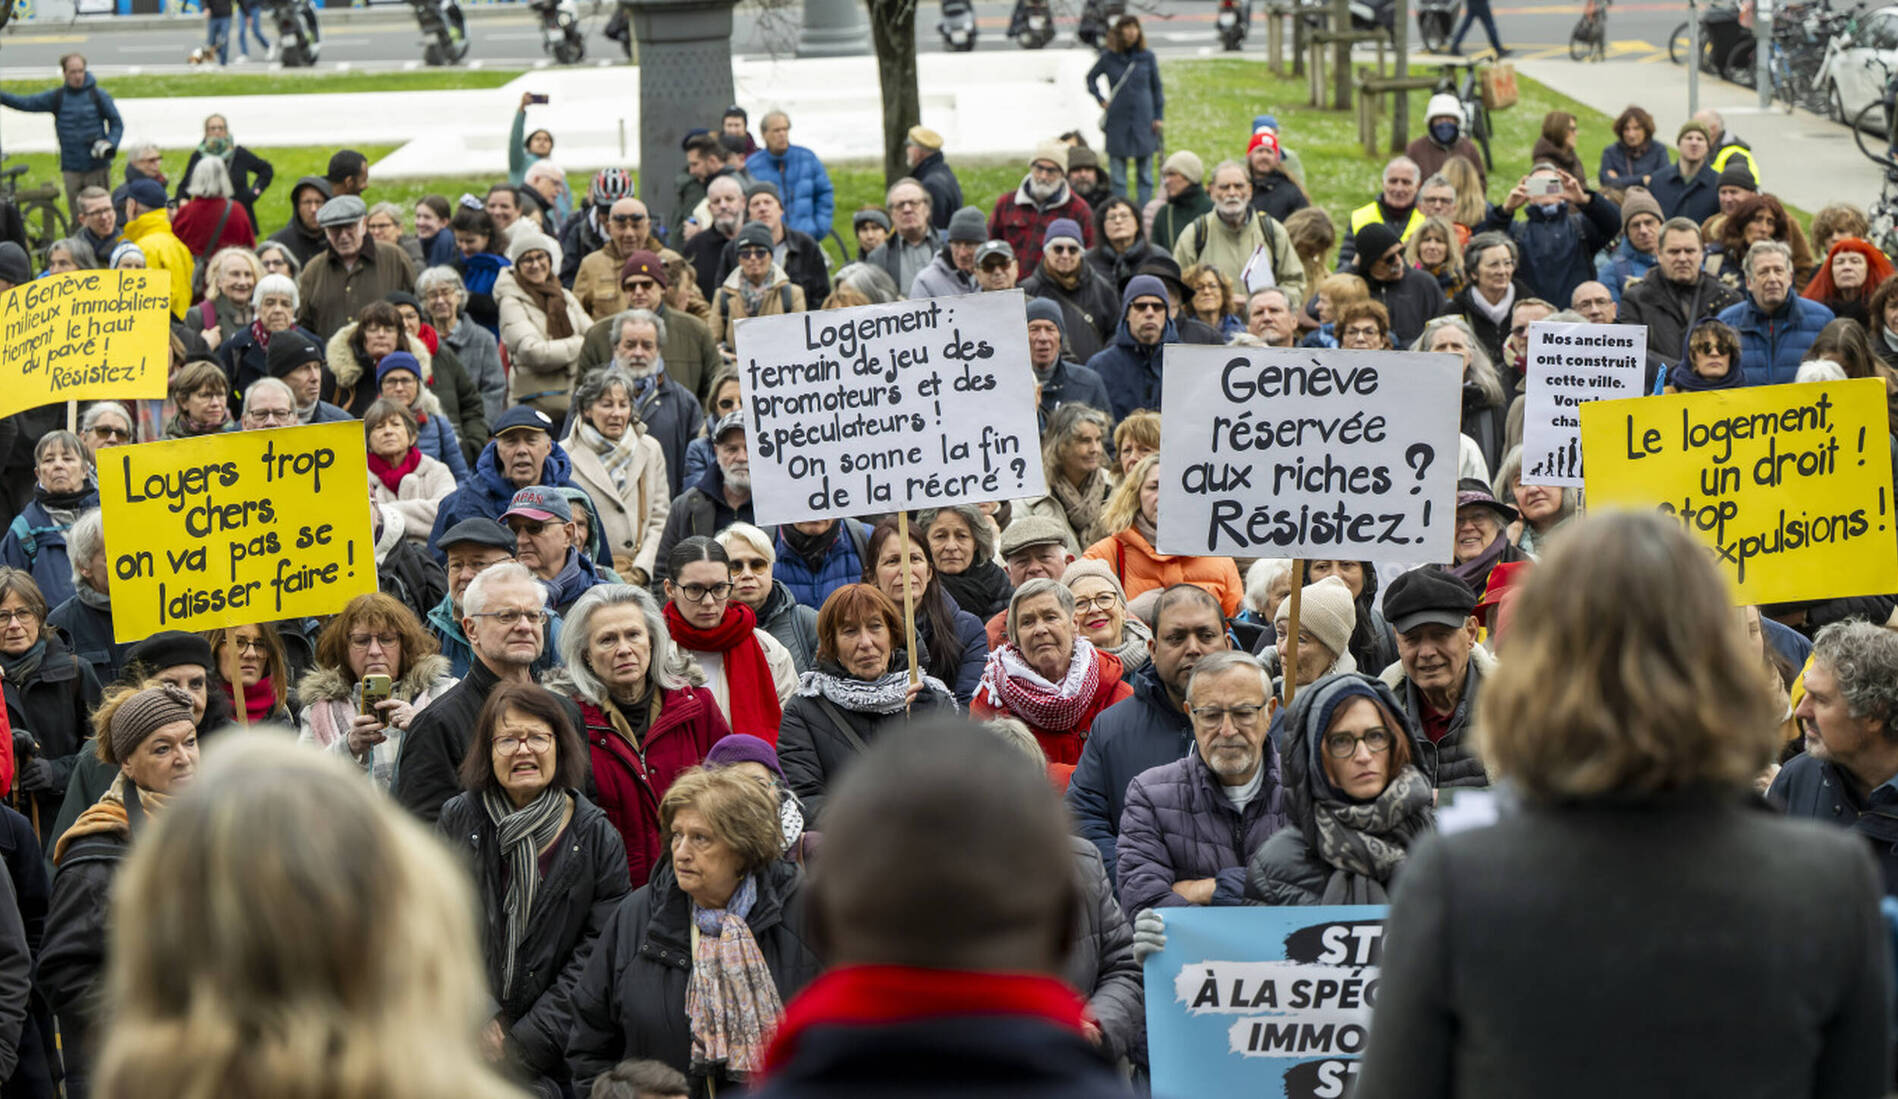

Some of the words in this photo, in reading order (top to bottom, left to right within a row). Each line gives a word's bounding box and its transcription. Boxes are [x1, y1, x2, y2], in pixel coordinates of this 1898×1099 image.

[118, 270, 147, 293] les
[5, 304, 61, 342] milieux
[71, 292, 170, 316] immobiliers
[3, 325, 55, 366] tiennent
[66, 319, 81, 341] le
[87, 315, 135, 338] haut
[747, 354, 841, 391] terrain
[852, 343, 883, 377] de
[885, 346, 929, 384] jeu
[943, 328, 995, 362] des
[1536, 354, 1563, 366] ont
[1566, 355, 1637, 369] construit
[1542, 332, 1572, 346] Nos
[1574, 334, 1634, 348] anciens
[22, 350, 41, 376] du
[1221, 356, 1379, 404] Genève
[1546, 375, 1585, 388] cette
[1588, 375, 1626, 389] ville.
[751, 384, 903, 433] promoteurs
[917, 371, 943, 397] et
[953, 364, 998, 393] des
[1211, 410, 1387, 453] réservée
[1552, 415, 1582, 428] cha
[1626, 413, 1664, 460] Le
[1683, 392, 1834, 464] logement,
[839, 445, 923, 475] sonne
[941, 433, 970, 465] la
[978, 425, 1020, 473] fin
[122, 455, 240, 513] Loyers
[261, 440, 336, 494] trop
[808, 475, 851, 511] de
[866, 473, 892, 505] la
[1181, 461, 1253, 495] aux
[1700, 465, 1740, 497] un
[185, 495, 278, 538] chers,
[115, 551, 154, 580] on
[167, 546, 207, 574] va
[230, 531, 281, 582] pas
[296, 523, 333, 549] se
[1706, 508, 1869, 584] xpulsions
[159, 580, 261, 625] laisser
[1317, 925, 1390, 966] ST
[1191, 969, 1221, 1009] À
[1229, 979, 1279, 1009] LA
